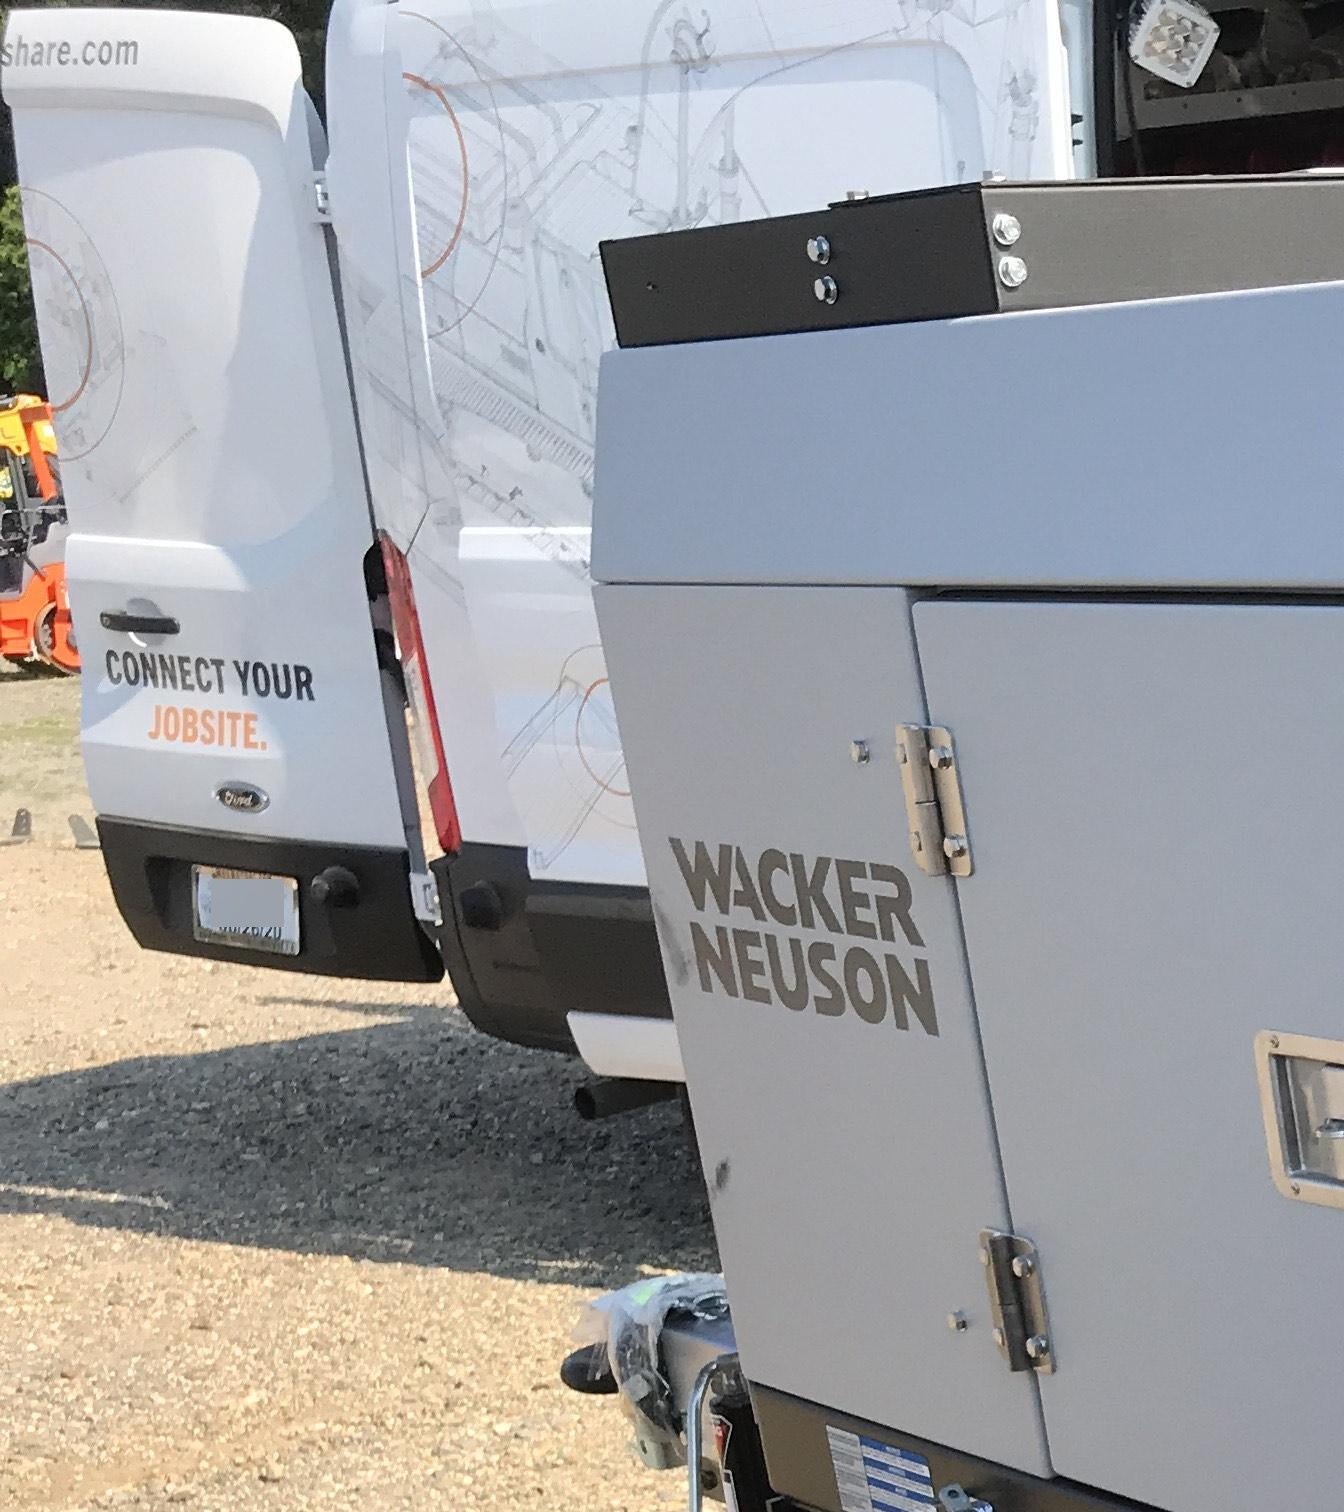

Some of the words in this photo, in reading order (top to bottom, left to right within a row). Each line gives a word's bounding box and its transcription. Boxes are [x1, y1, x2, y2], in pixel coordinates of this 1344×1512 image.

[0, 34, 139, 67] share.com
[105, 649, 225, 694] CONNECT
[232, 660, 315, 701] YOUR
[148, 705, 267, 751] JOBSITE.
[668, 836, 927, 948] WACKER
[690, 921, 940, 1038] NEUSON
